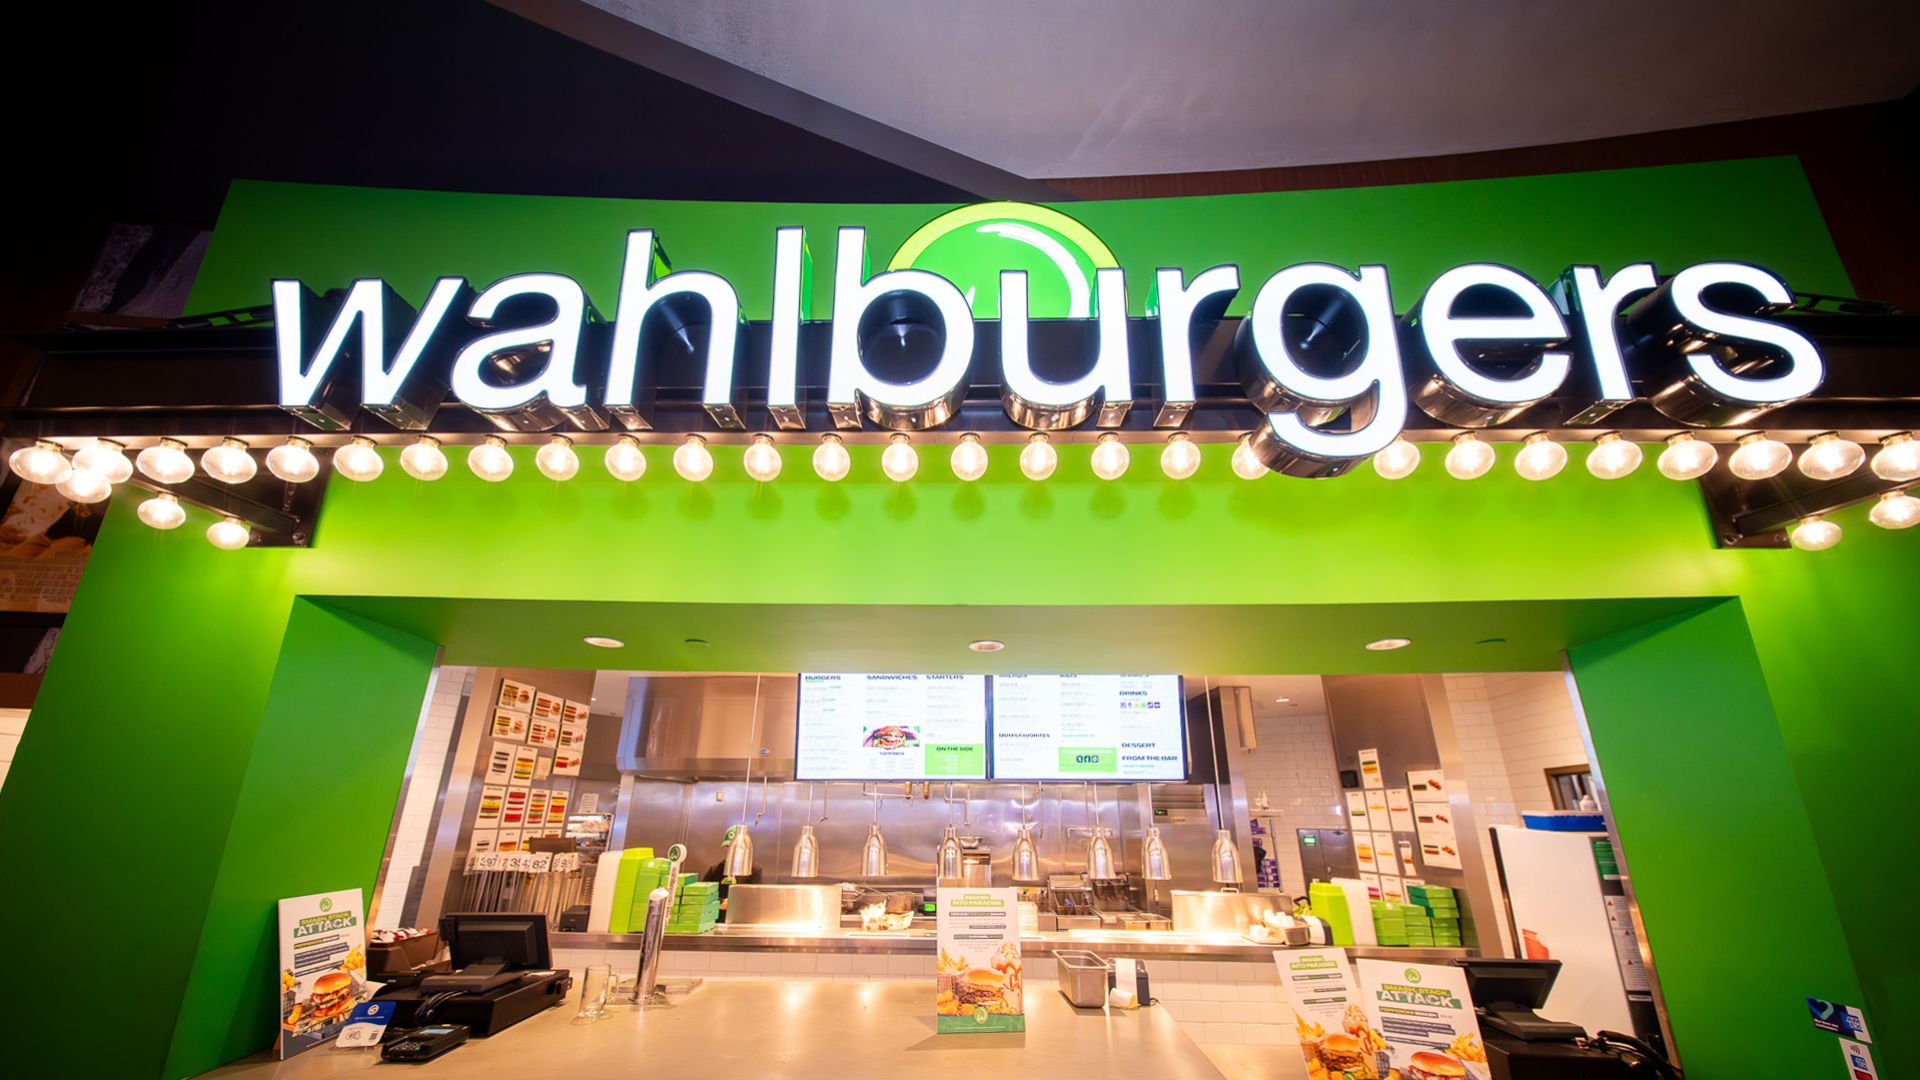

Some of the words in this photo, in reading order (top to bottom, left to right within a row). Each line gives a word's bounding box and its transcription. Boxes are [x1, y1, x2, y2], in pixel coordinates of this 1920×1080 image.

[273, 225, 1825, 457] wahlburgers
[532, 860, 548, 869] 82
[297, 917, 351, 936] ATTACK
[1380, 990, 1454, 1008] ATTACK
